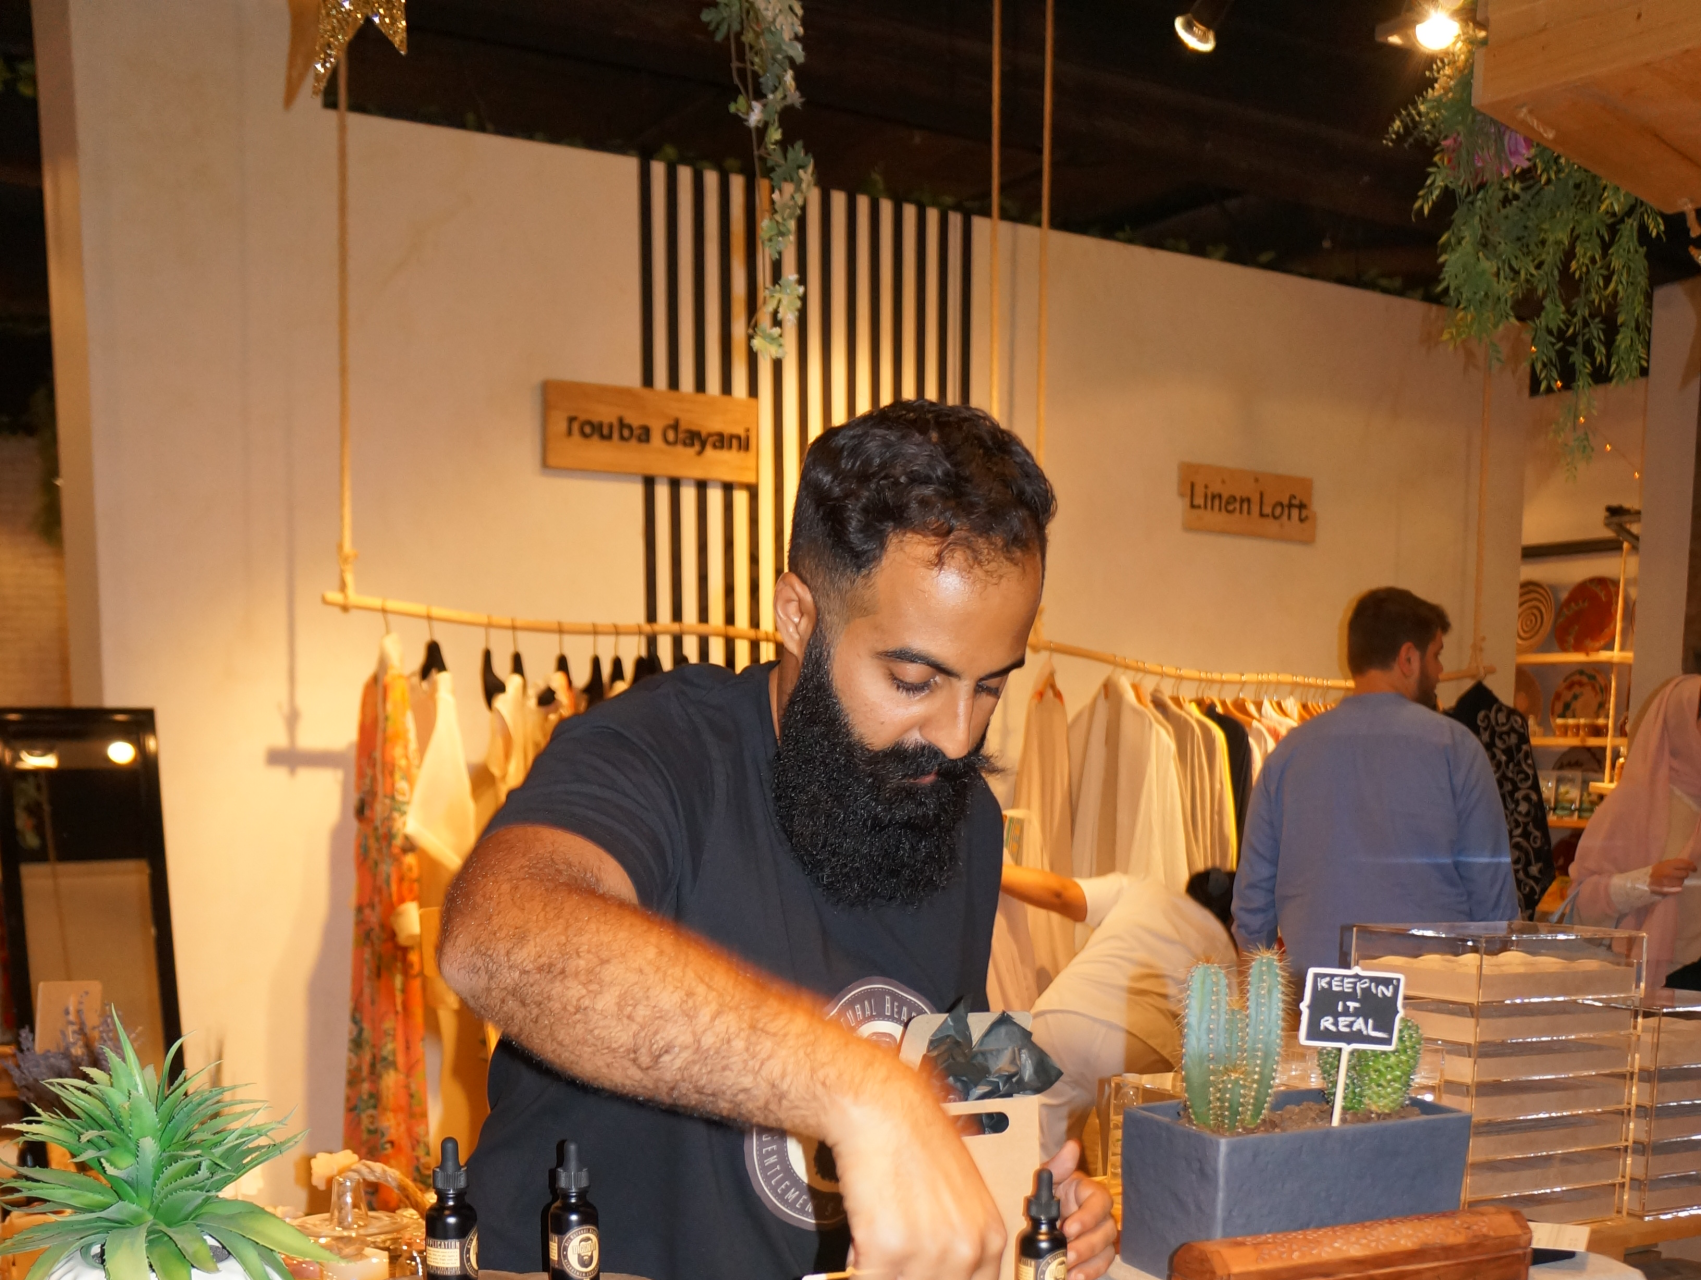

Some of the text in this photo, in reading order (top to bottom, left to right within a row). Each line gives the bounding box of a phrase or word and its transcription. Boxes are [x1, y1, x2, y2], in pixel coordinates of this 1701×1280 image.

[567, 416, 750, 455] rouba dayani
[1190, 481, 1308, 523] Linen Loft
[1317, 976, 1397, 998] KEEPIN'
[1338, 1001, 1360, 1013] IT
[1320, 1016, 1389, 1038] REAL
